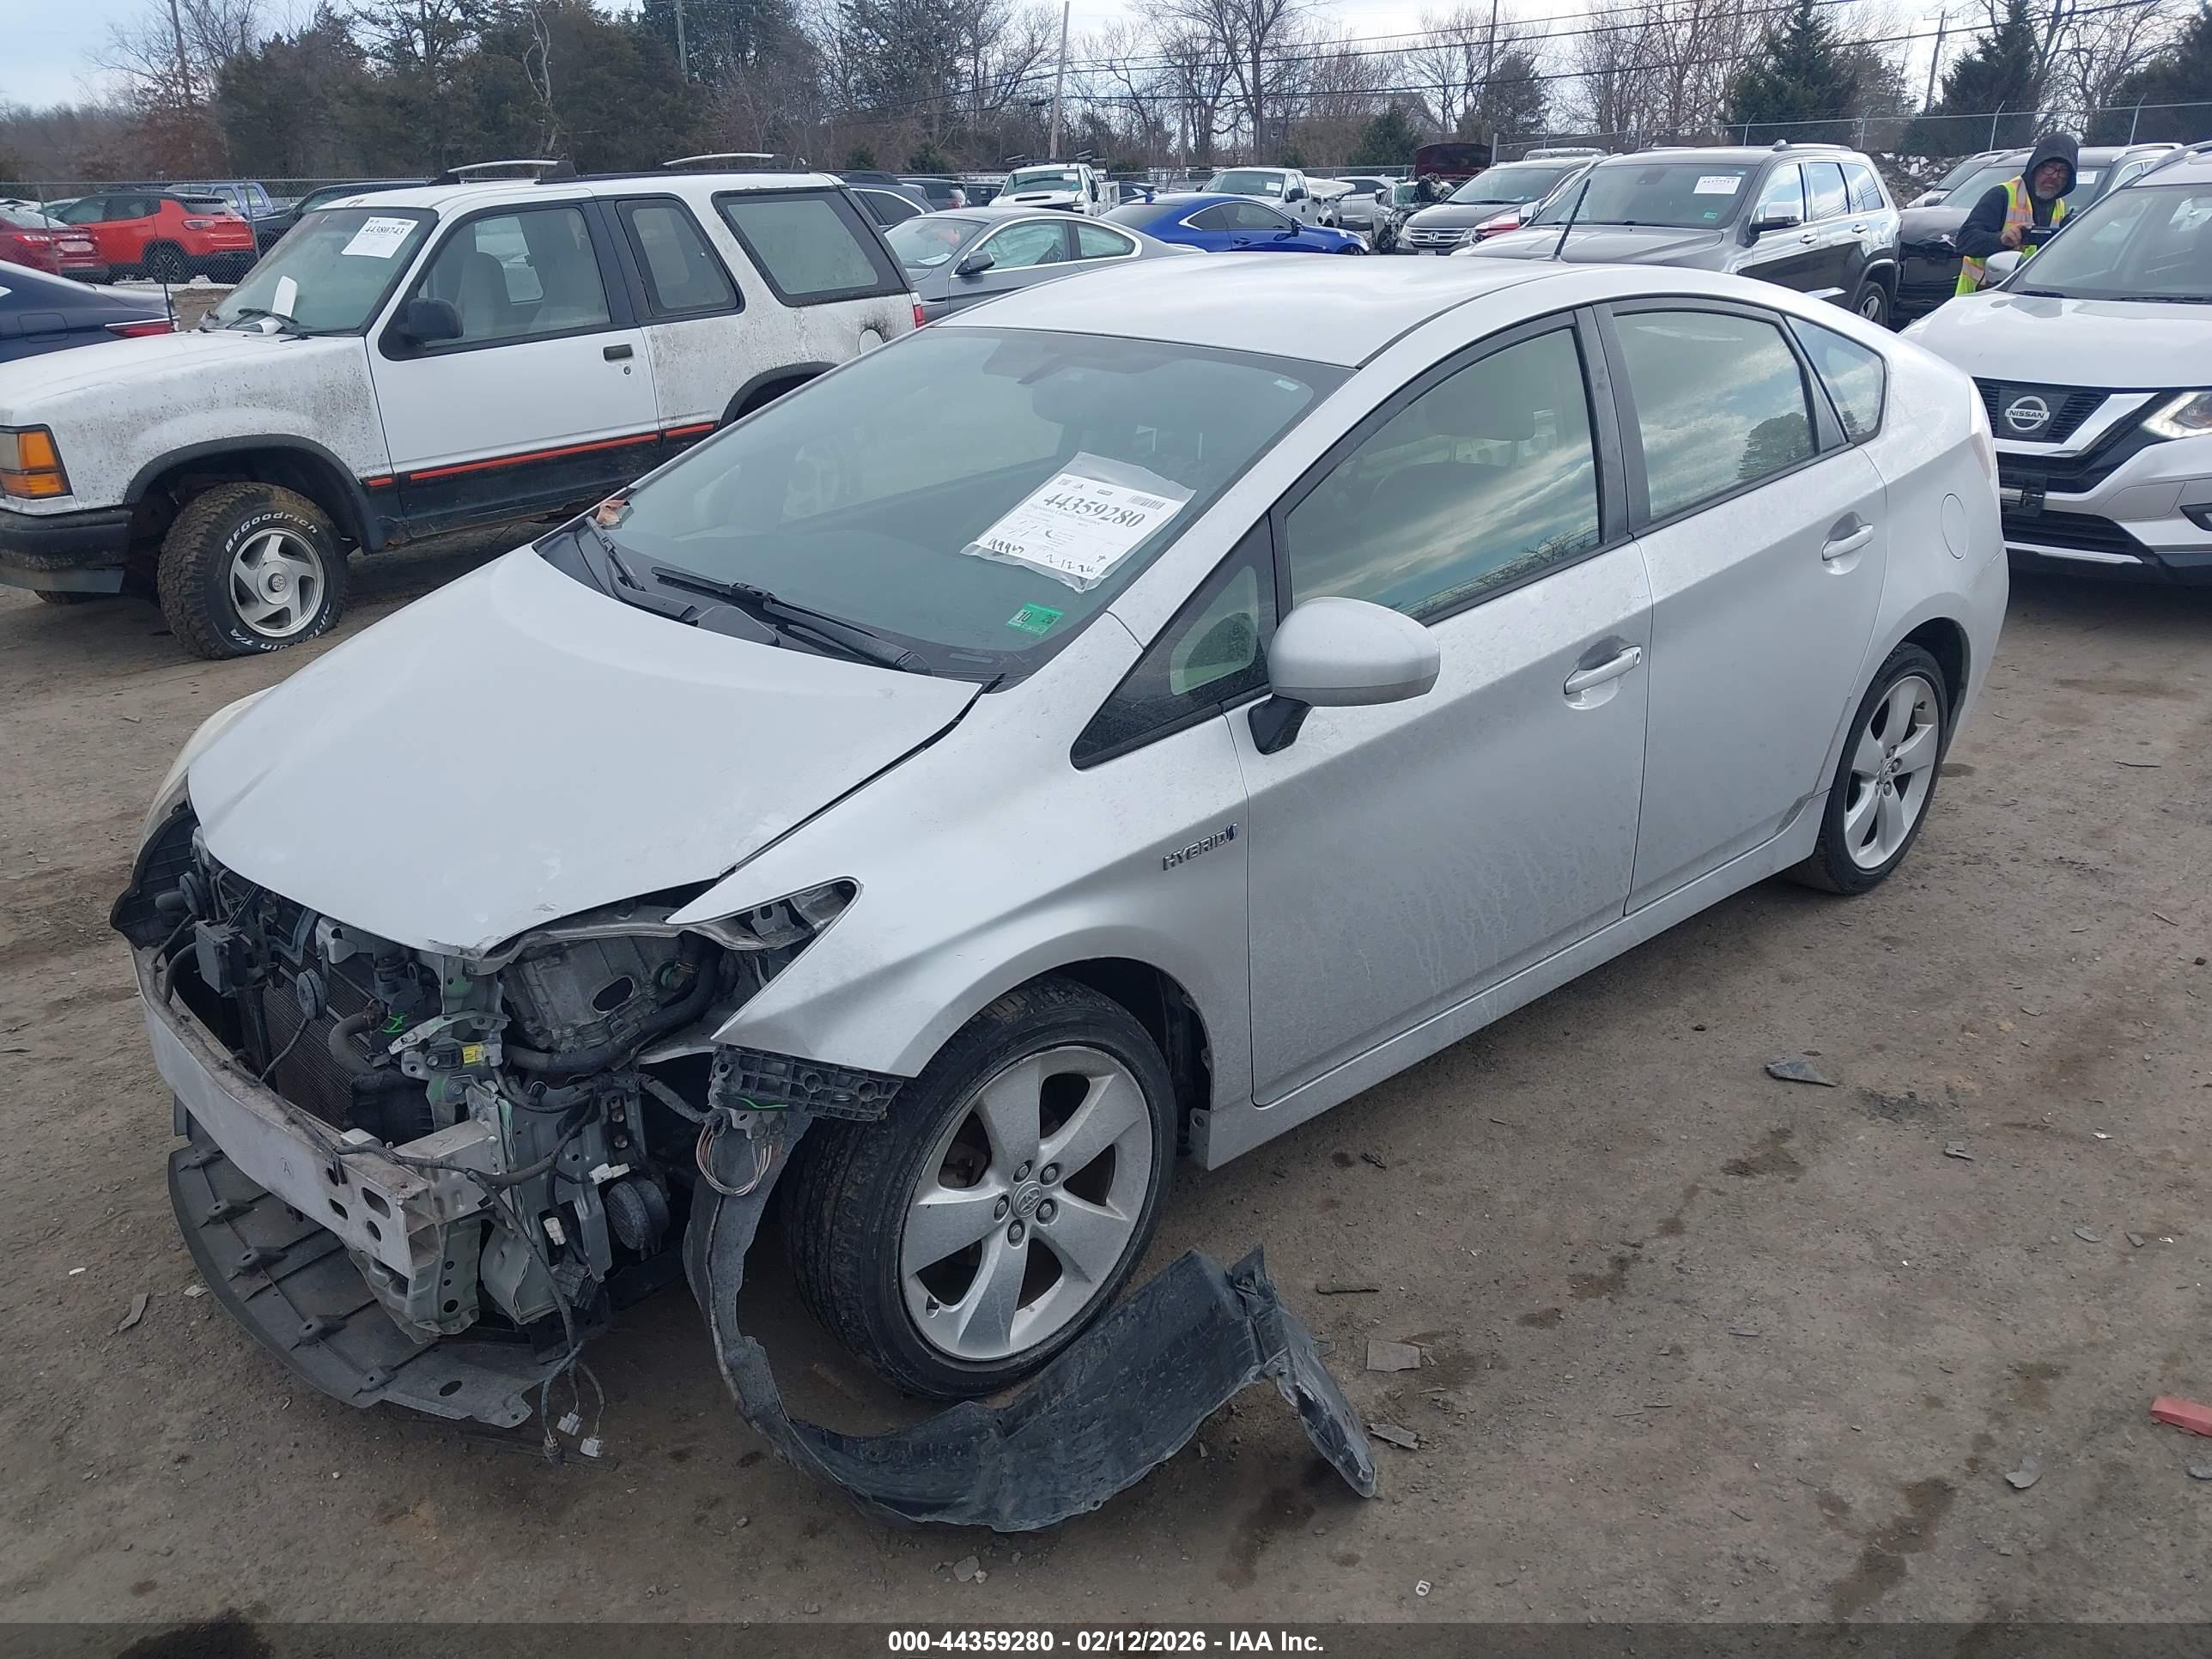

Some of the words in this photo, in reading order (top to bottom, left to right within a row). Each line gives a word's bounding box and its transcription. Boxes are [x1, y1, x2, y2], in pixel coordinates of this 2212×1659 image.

[2009, 410, 2045, 419] NISSAN
[1044, 493, 1146, 527] 44359280
[225, 511, 319, 553] BFGoodrich
[1018, 611, 1034, 623] 10
[229, 628, 255, 646] T/A
[1163, 830, 1228, 871] HYBRID
